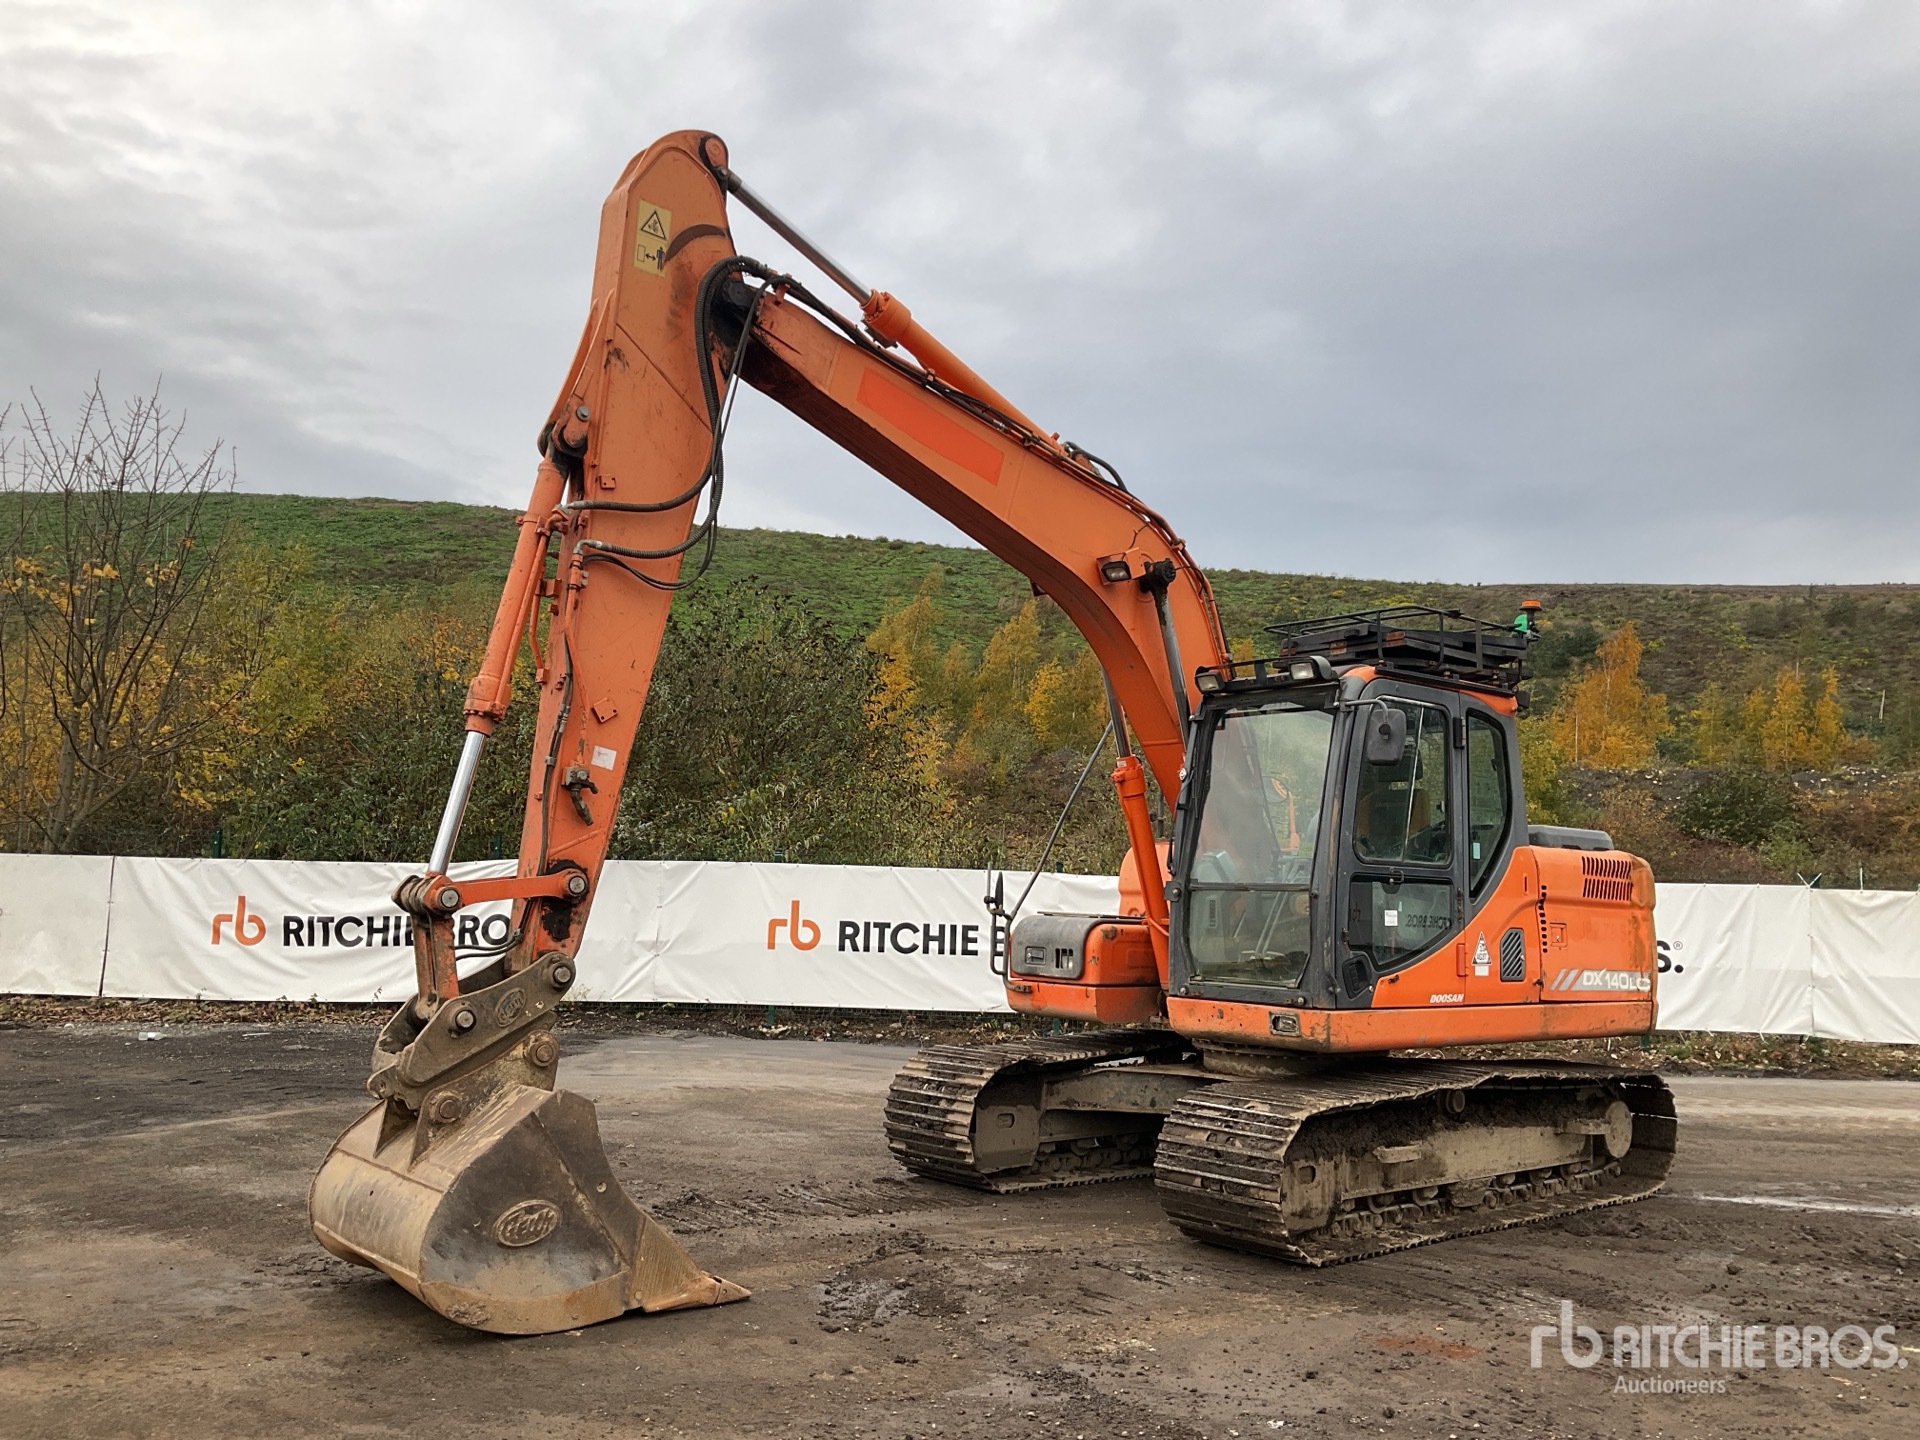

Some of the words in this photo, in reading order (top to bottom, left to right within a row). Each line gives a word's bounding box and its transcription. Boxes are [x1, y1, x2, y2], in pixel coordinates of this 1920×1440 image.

[211, 896, 266, 946] rb
[767, 900, 821, 951] rb
[838, 920, 979, 956] RITCHIE
[1430, 993, 1464, 1004] DOOSAN
